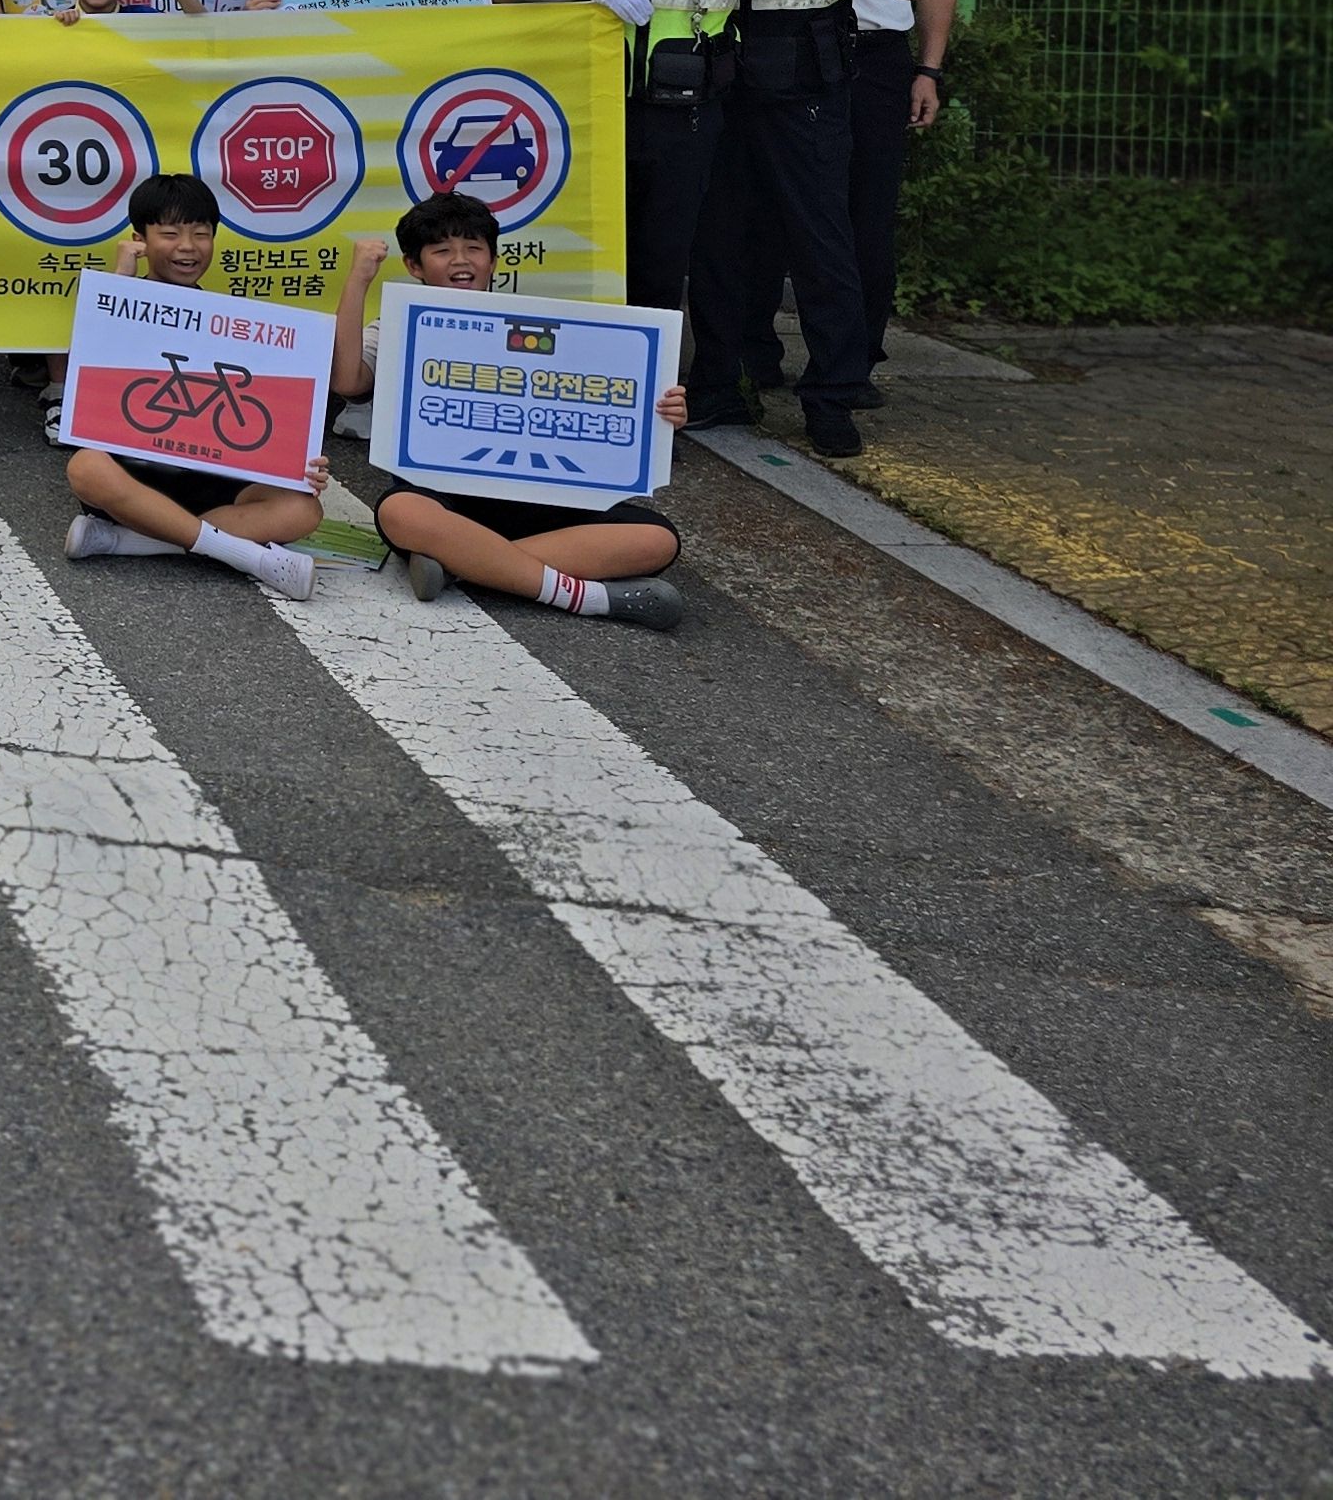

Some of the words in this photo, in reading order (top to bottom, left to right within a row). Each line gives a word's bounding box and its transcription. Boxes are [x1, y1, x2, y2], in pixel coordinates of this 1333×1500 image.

[37, 137, 111, 186] 30
[242, 135, 315, 162] STOP
[260, 168, 301, 190] 정지
[38, 252, 107, 273] 속도는
[219, 248, 309, 273] 횡단보도
[317, 246, 340, 272] 앞
[494, 240, 547, 266] 정차
[228, 275, 274, 297] 잠깐
[281, 274, 326, 297] 멈춤
[96, 292, 202, 332] 픽시자전거
[209, 314, 296, 351] 이용자제
[420, 315, 495, 333] 내황초등학교
[421, 358, 526, 393] 어른들은
[530, 370, 637, 409] 안전운전
[419, 396, 523, 434] 우리들은
[528, 409, 635, 446] 안전보행
[152, 437, 223, 460] 내황초등학교
